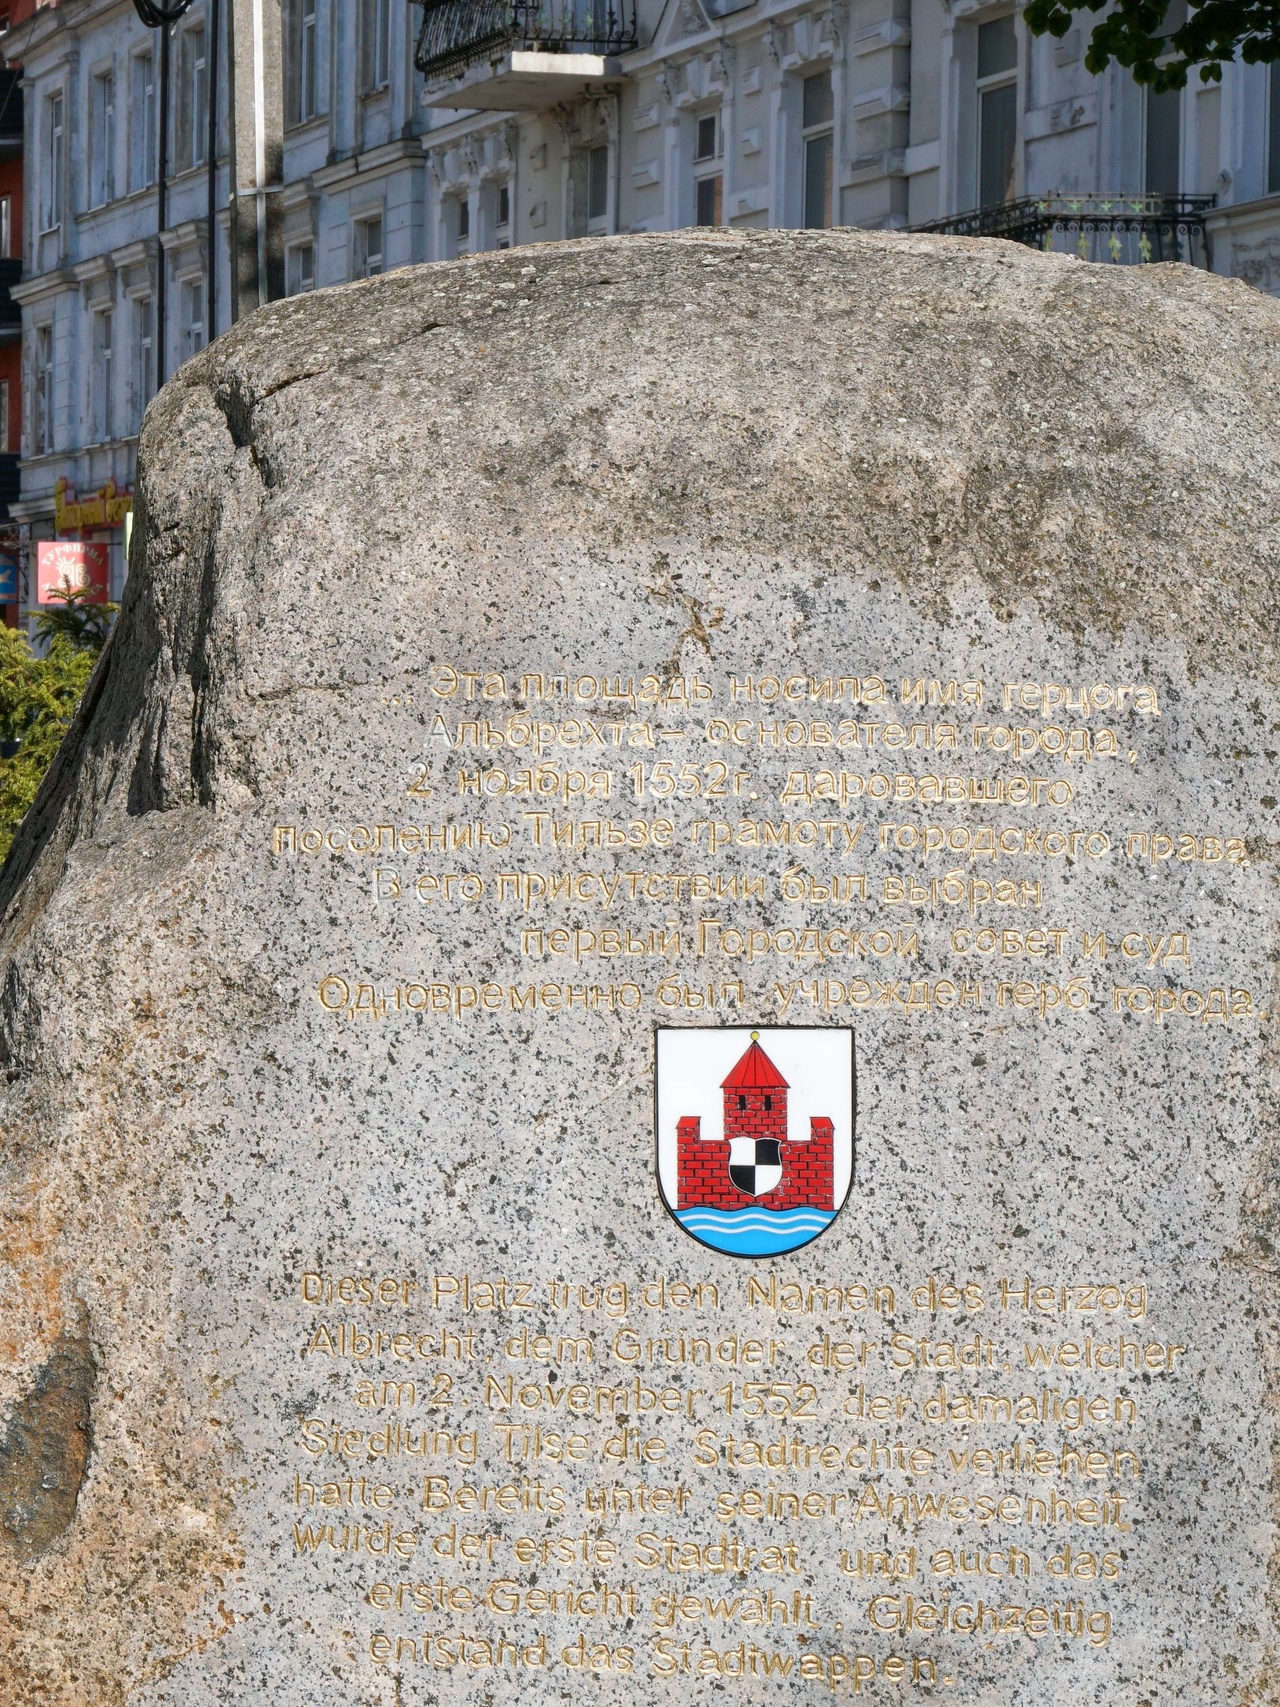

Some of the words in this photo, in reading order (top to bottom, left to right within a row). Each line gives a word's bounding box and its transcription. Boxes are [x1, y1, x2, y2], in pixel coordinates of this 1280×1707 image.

[41, 543, 104, 566] ТУРФИРМА
[430, 665, 508, 701] Эта
[521, 672, 714, 710] площадь
[730, 675, 888, 706] носила
[901, 678, 983, 707] имя
[1002, 679, 1161, 718] герцога
[706, 718, 958, 752] основателя
[972, 721, 1139, 764] города,
[407, 762, 434, 798] 2
[458, 766, 612, 805] ноября
[780, 770, 1074, 808] даровавшего
[273, 821, 512, 855] поселению
[522, 811, 673, 850] Тильзе
[690, 819, 865, 857] грамоту
[878, 820, 1109, 861] городского
[372, 868, 400, 903] В
[416, 874, 484, 906] его
[497, 870, 766, 910] присутствии
[780, 863, 867, 905] был
[882, 868, 1043, 917] выбран
[520, 918, 681, 965] первый
[697, 919, 920, 965] Городской
[949, 925, 1069, 959] совет
[1083, 931, 1107, 959] и
[1122, 932, 1192, 971] суд
[318, 974, 642, 1020] Одновременно
[657, 973, 745, 1009] был
[773, 978, 984, 1016] учрежден
[997, 976, 1091, 1019] герб
[1113, 985, 1270, 1022] города.
[301, 1271, 421, 1305] Dieser
[432, 1274, 535, 1312] Platz
[548, 1277, 629, 1320] trug
[642, 1274, 719, 1312] den
[748, 1275, 897, 1316] Namen
[911, 1276, 984, 1312] des
[1001, 1276, 1147, 1321] Herzog
[306, 1322, 492, 1365] Albrecht,
[505, 1327, 595, 1364] dem
[612, 1327, 787, 1368] Gründer
[806, 1333, 877, 1370] der
[1024, 1334, 1187, 1373] welcher
[355, 1378, 417, 1409] am
[484, 1373, 702, 1419] November
[717, 1380, 819, 1423] 1552
[842, 1383, 912, 1423] der
[923, 1384, 1137, 1433] damaligen
[299, 1419, 480, 1468] Siedlung
[495, 1423, 590, 1464] Tilse
[604, 1427, 668, 1465] die
[689, 1429, 937, 1477] Stadtrechte
[948, 1438, 1141, 1480] verliehen
[294, 1473, 395, 1511] hatte
[423, 1475, 567, 1515] Bereits
[584, 1481, 693, 1520] unter
[716, 1483, 847, 1524] seiner
[291, 1521, 419, 1560] wurde
[432, 1523, 501, 1564] der
[513, 1531, 618, 1567] erste
[633, 1530, 802, 1575] Stadtrat
[840, 1545, 917, 1580] und
[930, 1545, 1031, 1579] auch
[1046, 1545, 1122, 1581] das
[369, 1577, 474, 1612] erste
[485, 1579, 640, 1618] Gericht
[867, 1589, 1112, 1648] Gleichzeitig
[369, 1630, 548, 1670] entstand
[561, 1633, 635, 1674] das
